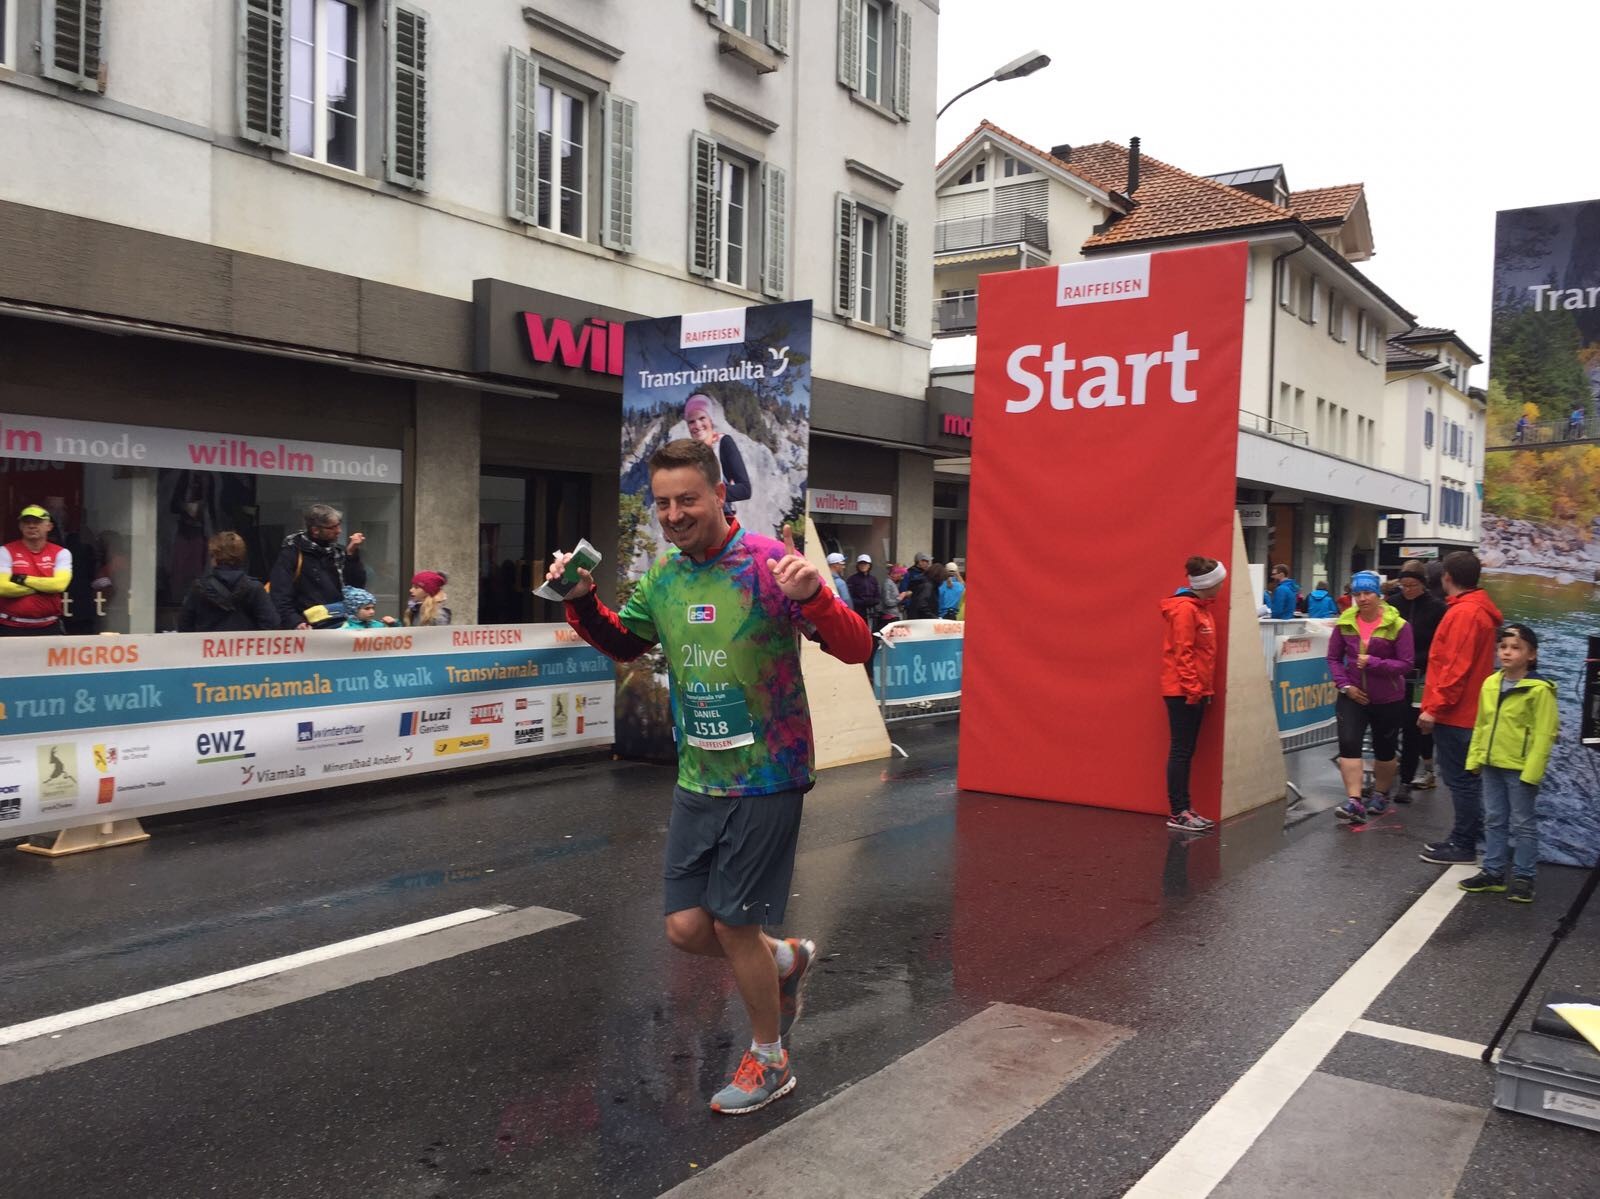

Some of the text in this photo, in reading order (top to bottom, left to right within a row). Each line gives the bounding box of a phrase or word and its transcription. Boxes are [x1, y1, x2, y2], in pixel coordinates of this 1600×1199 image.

[1063, 279, 1142, 300] RAIFFEISEN
[685, 327, 740, 344] RAIFFEISEN
[639, 361, 765, 389] Transruinaulta
[1005, 331, 1199, 413] Start
[55, 434, 146, 460] mode
[188, 440, 389, 479] wilhelm mode
[815, 493, 858, 512] wilhelm
[47, 644, 139, 667] MIGROS
[202, 636, 306, 658] RAIFFEISEN
[353, 635, 413, 652] MIGROS
[453, 629, 522, 646] RAIFFEISEN
[681, 644, 728, 667] 2live
[913, 654, 927, 684] &
[15, 697, 65, 718] run
[73, 688, 96, 714] &
[104, 684, 163, 711] walk
[192, 674, 333, 704] Transviamala
[336, 675, 369, 692] run
[373, 669, 390, 689] &
[392, 667, 433, 687] walk
[446, 660, 539, 684] Transviamala
[541, 661, 565, 676] run
[566, 657, 579, 674] &
[580, 655, 608, 672] walk
[421, 708, 452, 722] Luzi
[693, 709, 721, 718] DANIEL
[694, 721, 729, 736] 1518
[197, 730, 245, 755] ewz
[257, 765, 306, 783] Viamala
[322, 757, 371, 773] Mineralbad
